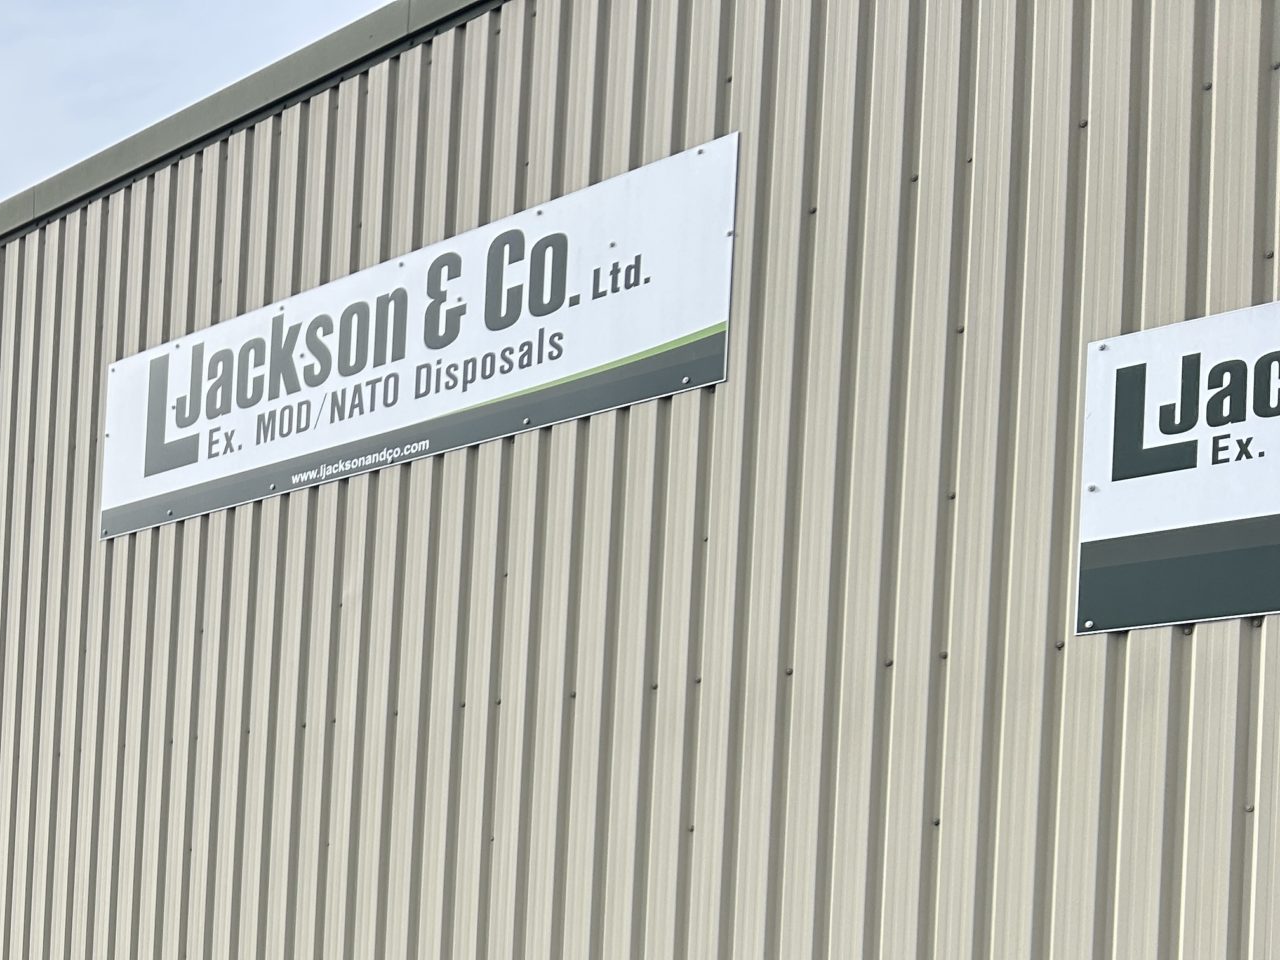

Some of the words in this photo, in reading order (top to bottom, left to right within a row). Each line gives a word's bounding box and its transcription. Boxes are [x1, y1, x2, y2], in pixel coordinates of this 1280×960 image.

[423, 251, 467, 350] &
[592, 254, 651, 300] Ltd.
[207, 427, 242, 459] Ex.
[255, 371, 400, 447] MOD/NATO
[415, 326, 565, 400] Disposals
[291, 438, 430, 487] www.ljacksonandco.com
[1211, 433, 1265, 466] Ex.
